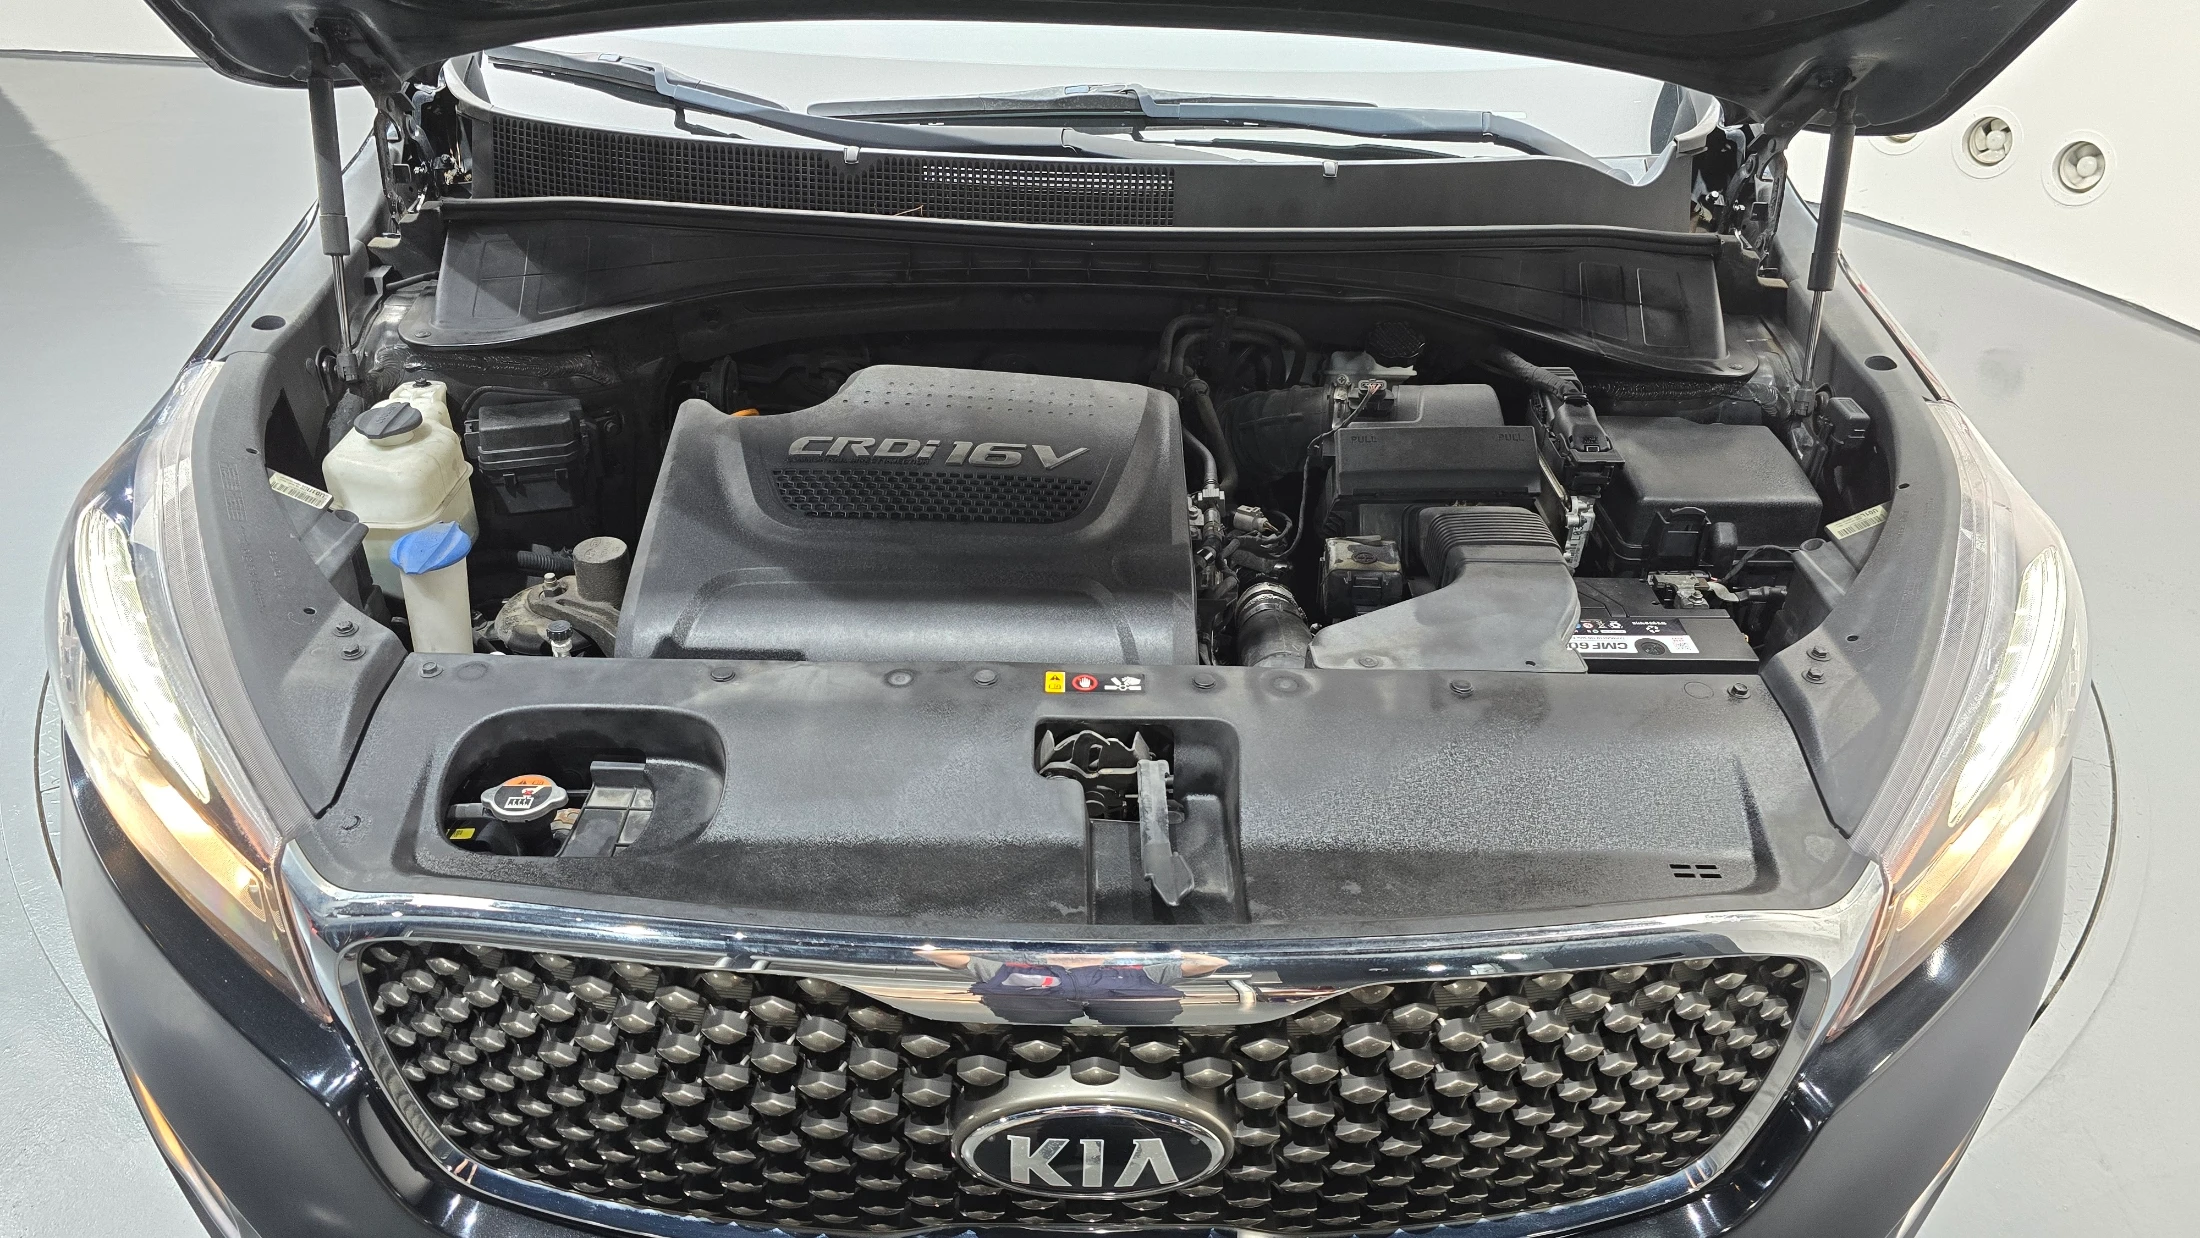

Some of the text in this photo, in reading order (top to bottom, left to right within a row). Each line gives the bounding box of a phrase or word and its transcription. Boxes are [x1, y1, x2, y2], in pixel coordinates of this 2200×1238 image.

[1351, 435, 1378, 443] PULL
[1498, 432, 1525, 442] PULL
[788, 435, 1090, 470] CRDi 16V
[1567, 642, 1628, 650] CMF 60
[1006, 1134, 1180, 1188] KIA
